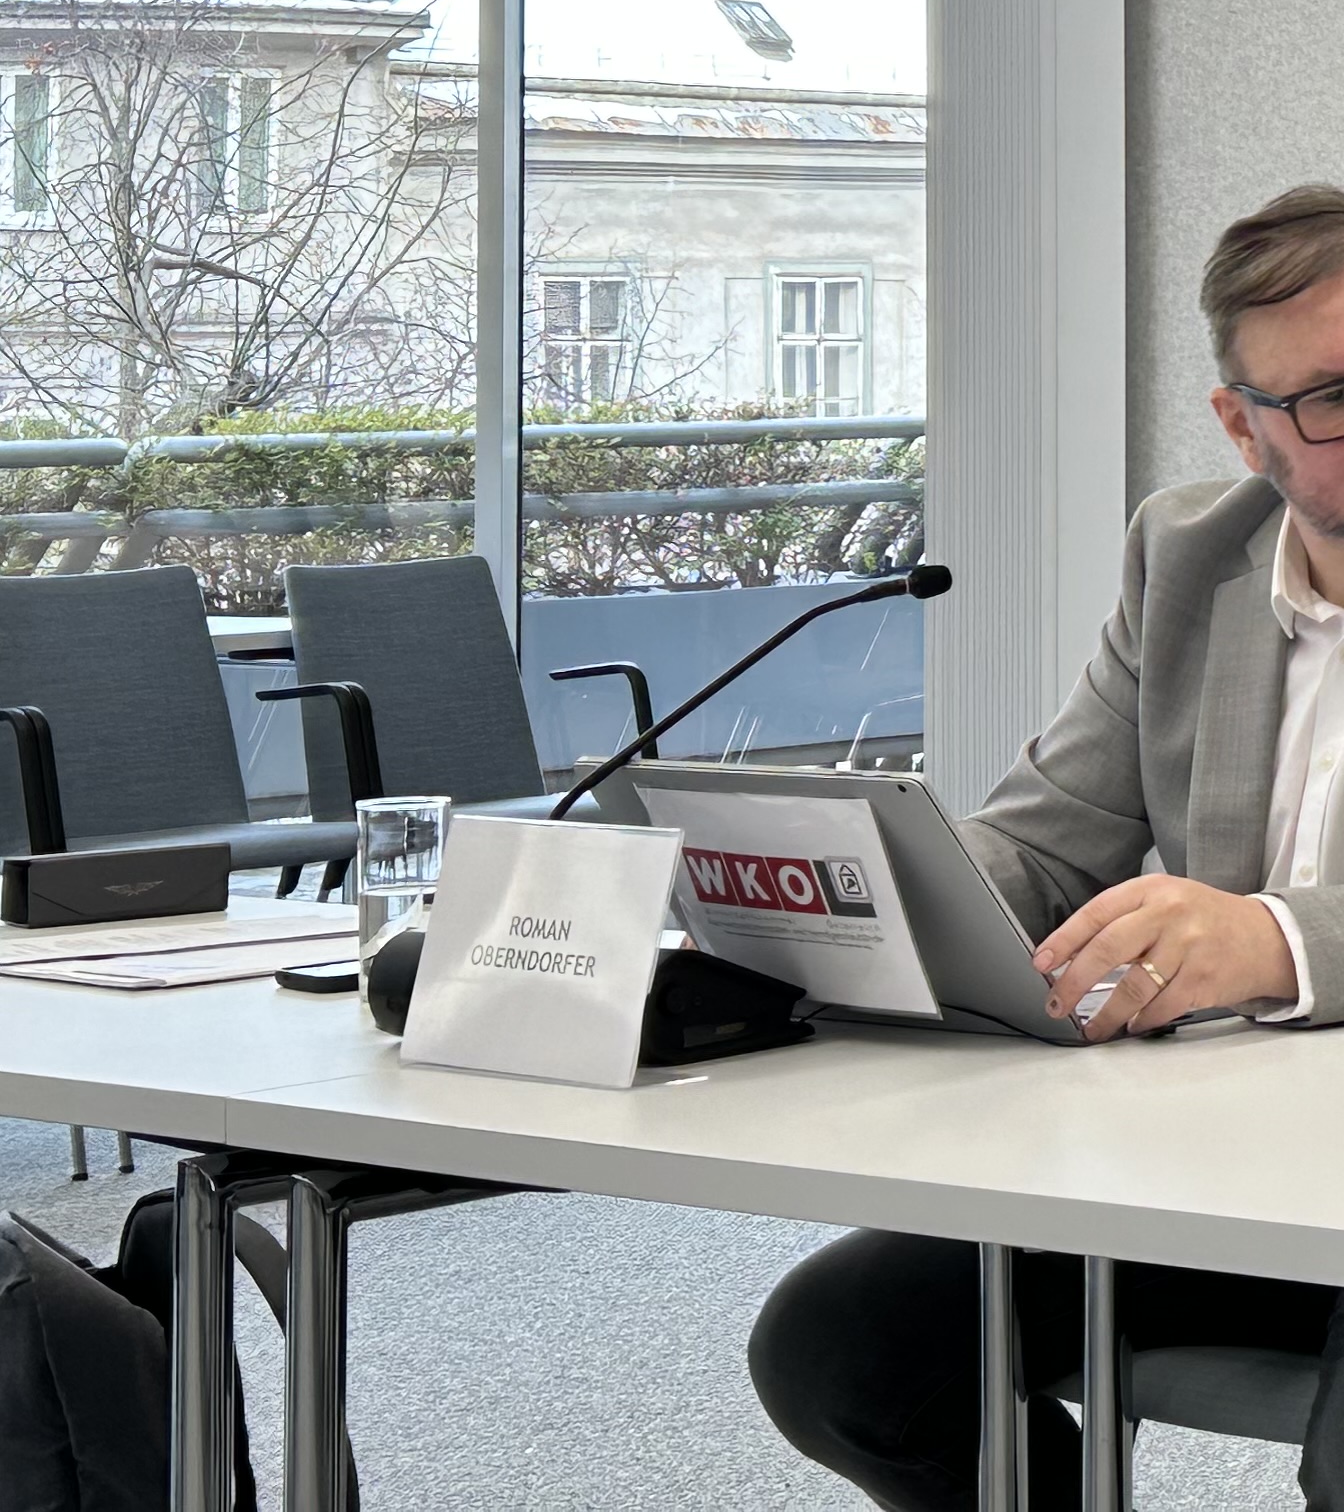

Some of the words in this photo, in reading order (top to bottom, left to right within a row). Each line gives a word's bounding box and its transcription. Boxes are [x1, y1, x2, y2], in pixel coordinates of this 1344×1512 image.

[686, 854, 815, 906] WKO
[509, 916, 572, 941] ROMAN
[471, 944, 596, 977] OBERNDORFER
